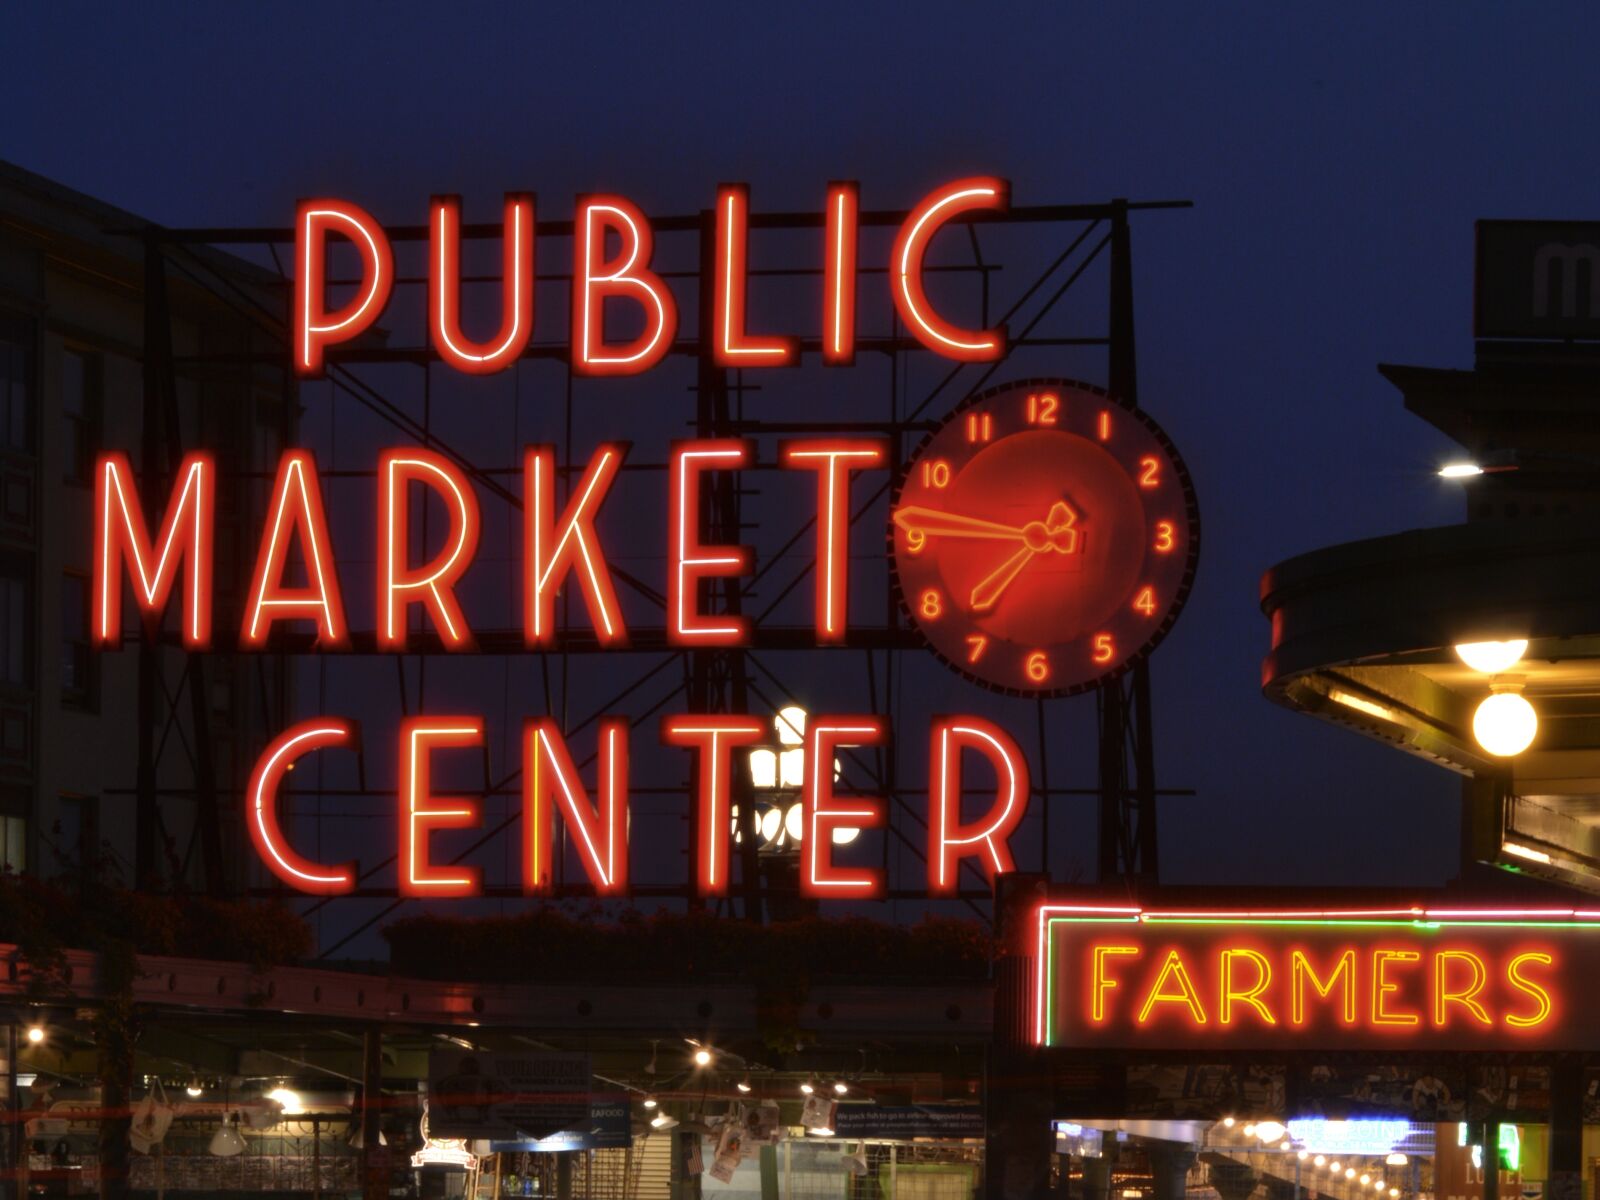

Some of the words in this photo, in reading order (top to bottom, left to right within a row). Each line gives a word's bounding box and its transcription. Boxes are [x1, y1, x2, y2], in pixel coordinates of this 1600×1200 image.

[294, 178, 1003, 378] PUBLIC
[1027, 395, 1058, 424] 12
[968, 413, 992, 441] 11
[922, 460, 951, 490] 10
[1139, 457, 1160, 487] 2
[92, 439, 884, 648] MARKET
[1155, 522, 1174, 553] 3
[920, 590, 942, 619] 8
[1133, 586, 1155, 616] 4
[967, 636, 988, 663] 7
[1093, 634, 1115, 663] 5
[1026, 652, 1048, 682] 6
[247, 714, 1028, 896] CENTER
[1088, 945, 1555, 1029] FARMERS
[591, 1109, 624, 1118] EAFOOD
